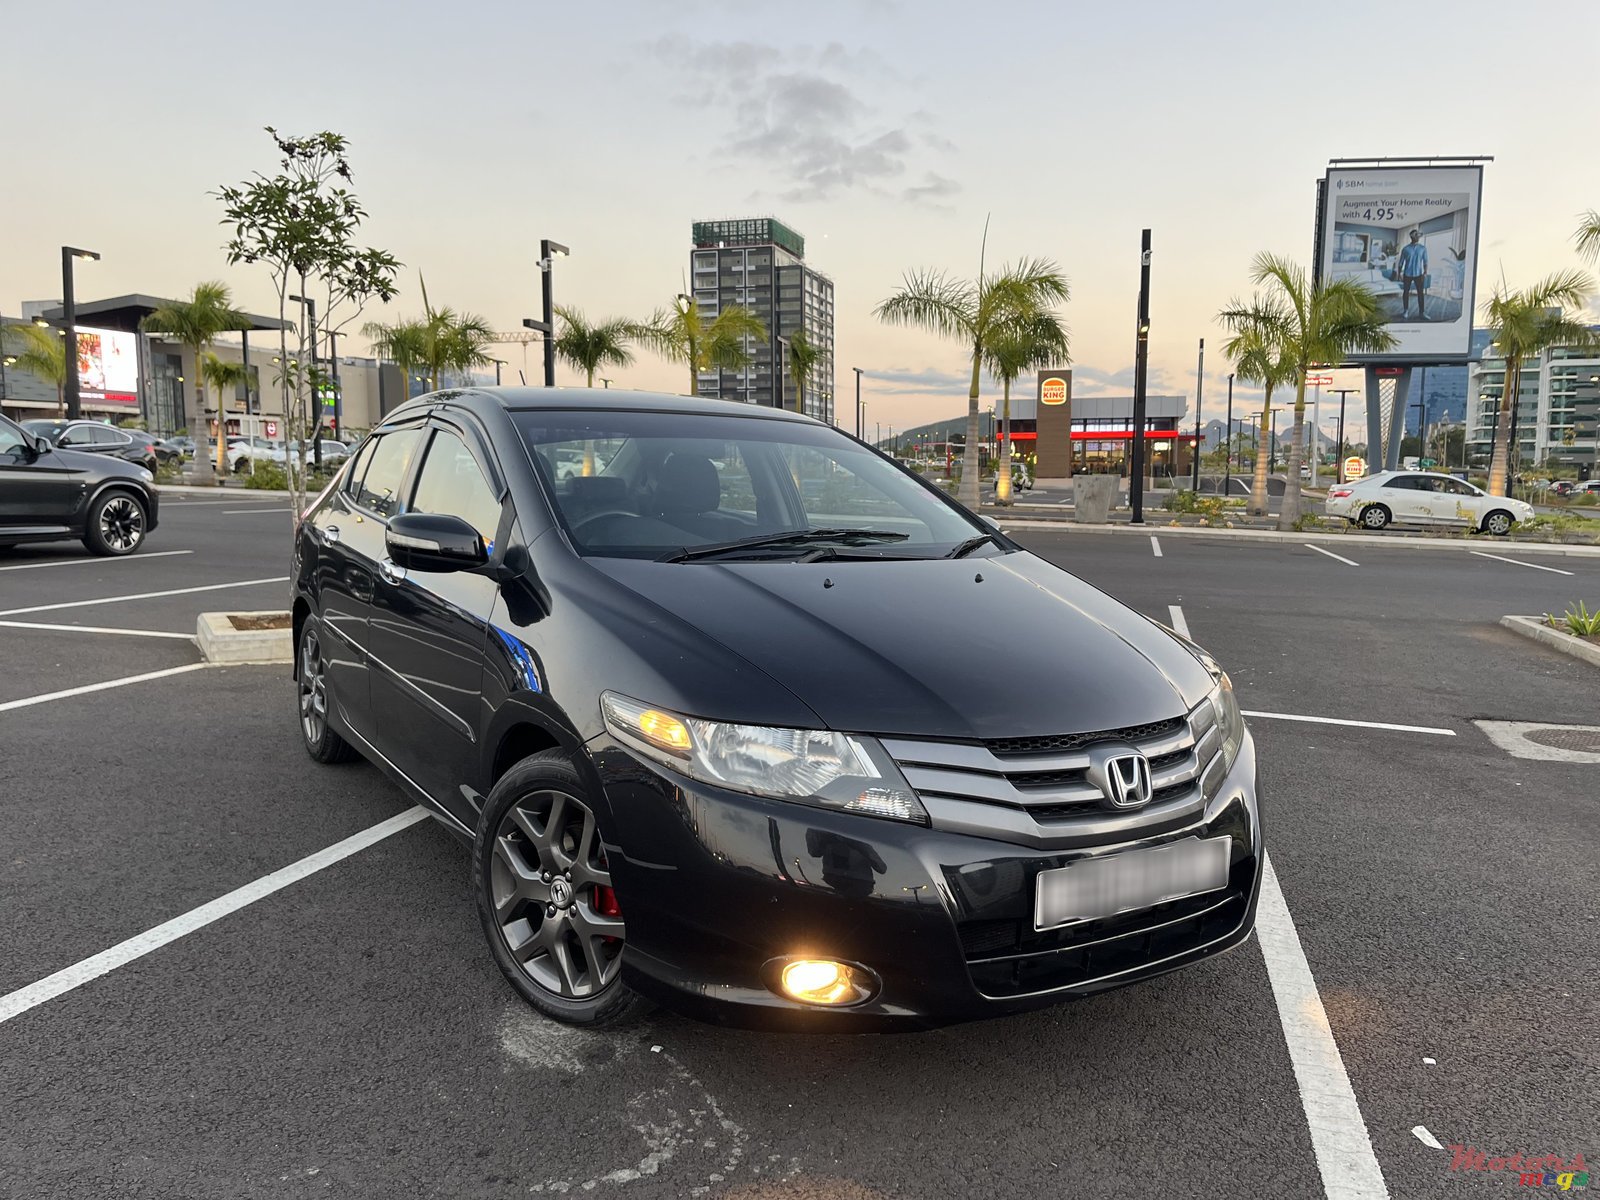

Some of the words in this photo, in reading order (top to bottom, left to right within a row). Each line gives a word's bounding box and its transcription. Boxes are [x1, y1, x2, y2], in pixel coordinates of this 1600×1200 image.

[1345, 180, 1365, 188] SBM
[1343, 200, 1378, 209] Augment
[1380, 199, 1398, 207] Your
[1425, 198, 1452, 207] Reality
[1342, 211, 1360, 219] with
[1043, 391, 1065, 399] KING
